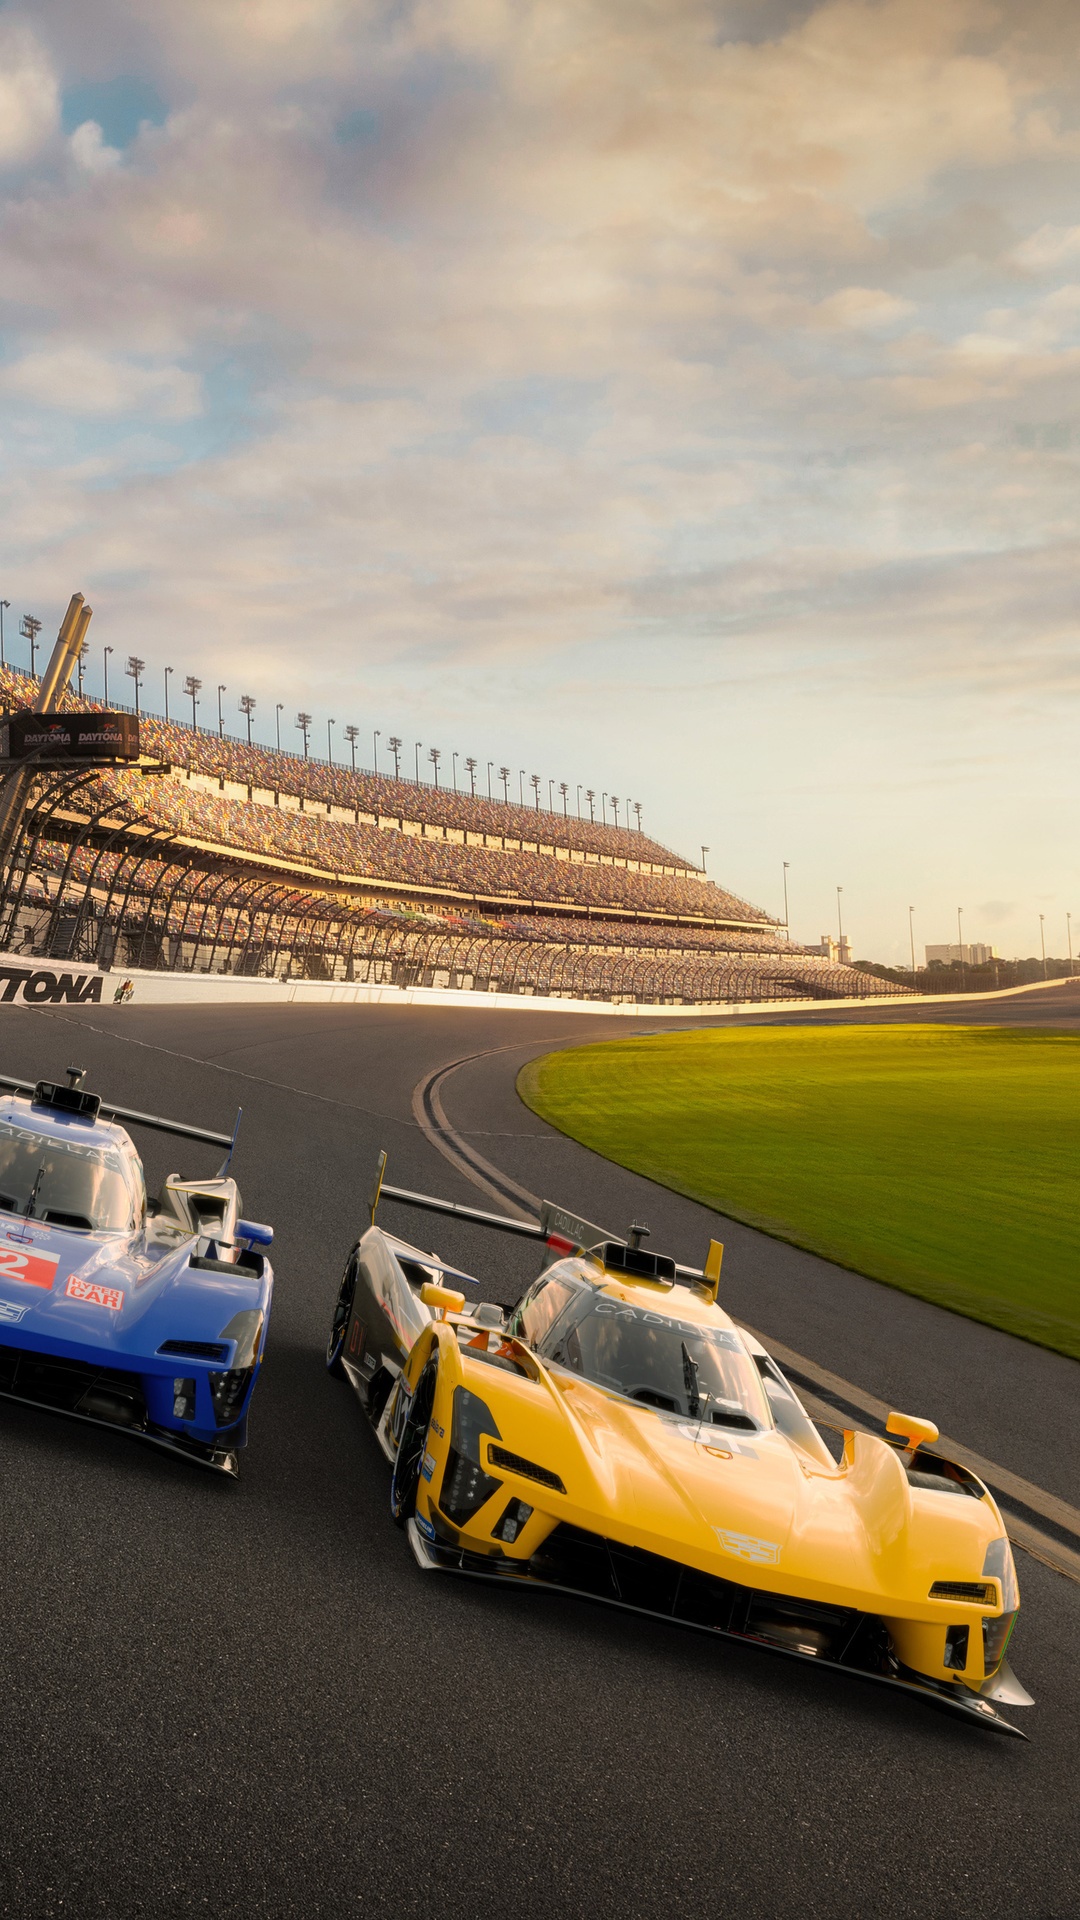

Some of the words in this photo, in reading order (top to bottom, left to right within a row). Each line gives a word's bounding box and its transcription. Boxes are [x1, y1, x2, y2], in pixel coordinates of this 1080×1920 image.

[24, 733, 71, 742] DAYTONA
[78, 733, 123, 741] DAYTONA
[0, 966, 104, 1003] TONA
[554, 1212, 585, 1240] CADILLAC
[0, 1250, 29, 1280] 2
[70, 1286, 119, 1308] CAR
[71, 1278, 120, 1298] HYPER
[349, 1320, 364, 1356] 01
[677, 1423, 742, 1454] 01
